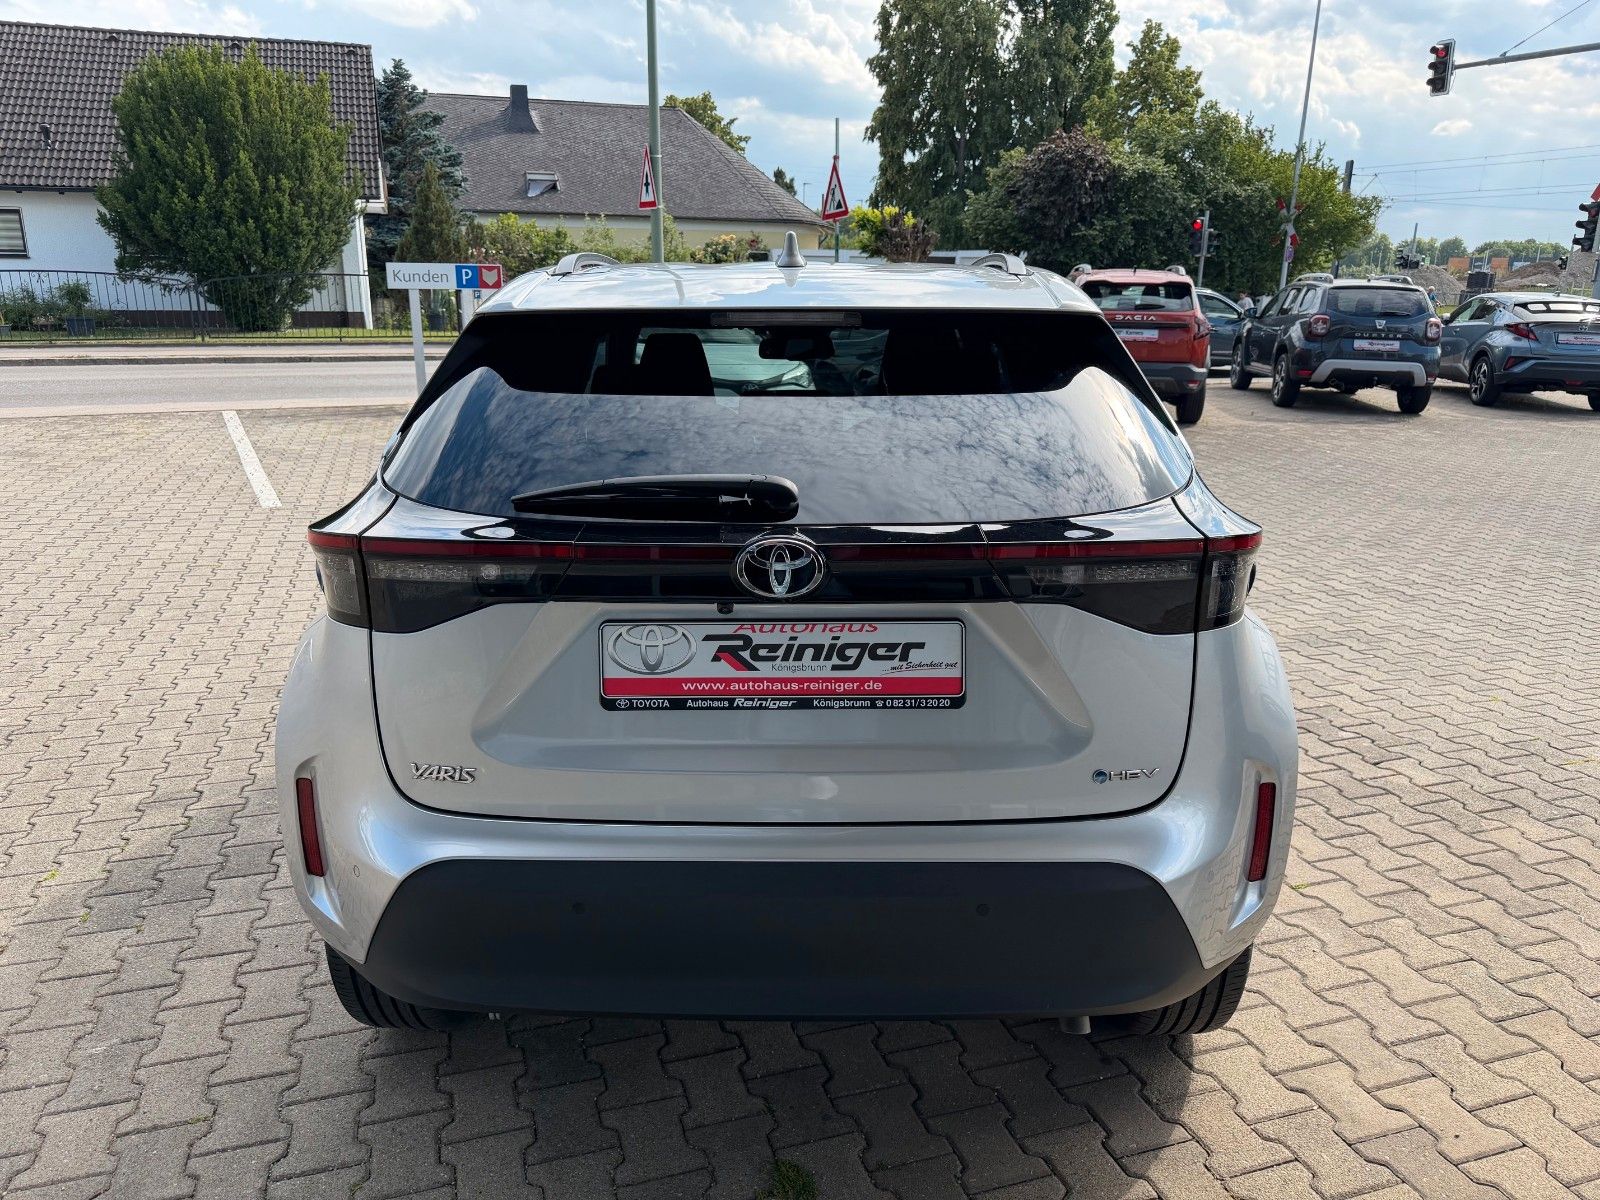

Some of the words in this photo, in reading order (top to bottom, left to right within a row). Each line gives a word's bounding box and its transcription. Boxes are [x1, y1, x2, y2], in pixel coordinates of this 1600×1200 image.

[392, 269, 449, 283] Kunden
[462, 268, 472, 286] P
[701, 633, 926, 671] Reiniger
[771, 663, 828, 674] Königsbrunn
[682, 681, 882, 692] www.autohaus-reiniger.de
[633, 700, 670, 708] TOYOTA
[686, 699, 729, 708] Autohaus
[733, 698, 797, 709] Reiniger
[813, 698, 871, 709] Königsbrunn
[410, 763, 477, 784] YARIS
[1109, 768, 1160, 781] HEV
